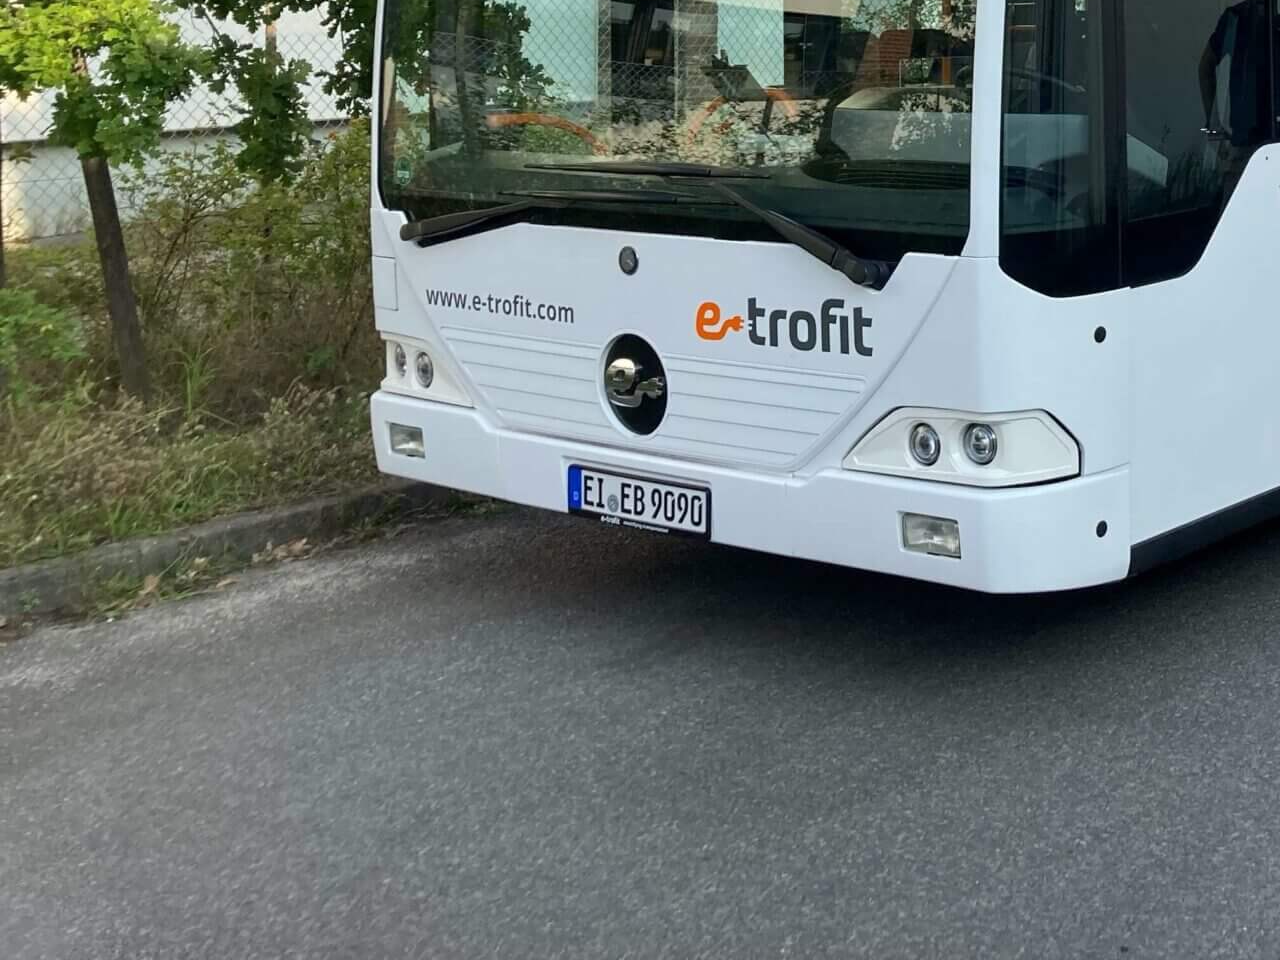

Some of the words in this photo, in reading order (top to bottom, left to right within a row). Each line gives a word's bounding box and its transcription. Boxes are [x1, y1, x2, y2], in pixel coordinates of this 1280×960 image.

[425, 289, 574, 323] www.e-trofit.com
[583, 475, 605, 508] EI
[621, 483, 645, 516] EB
[651, 488, 702, 527] 9090
